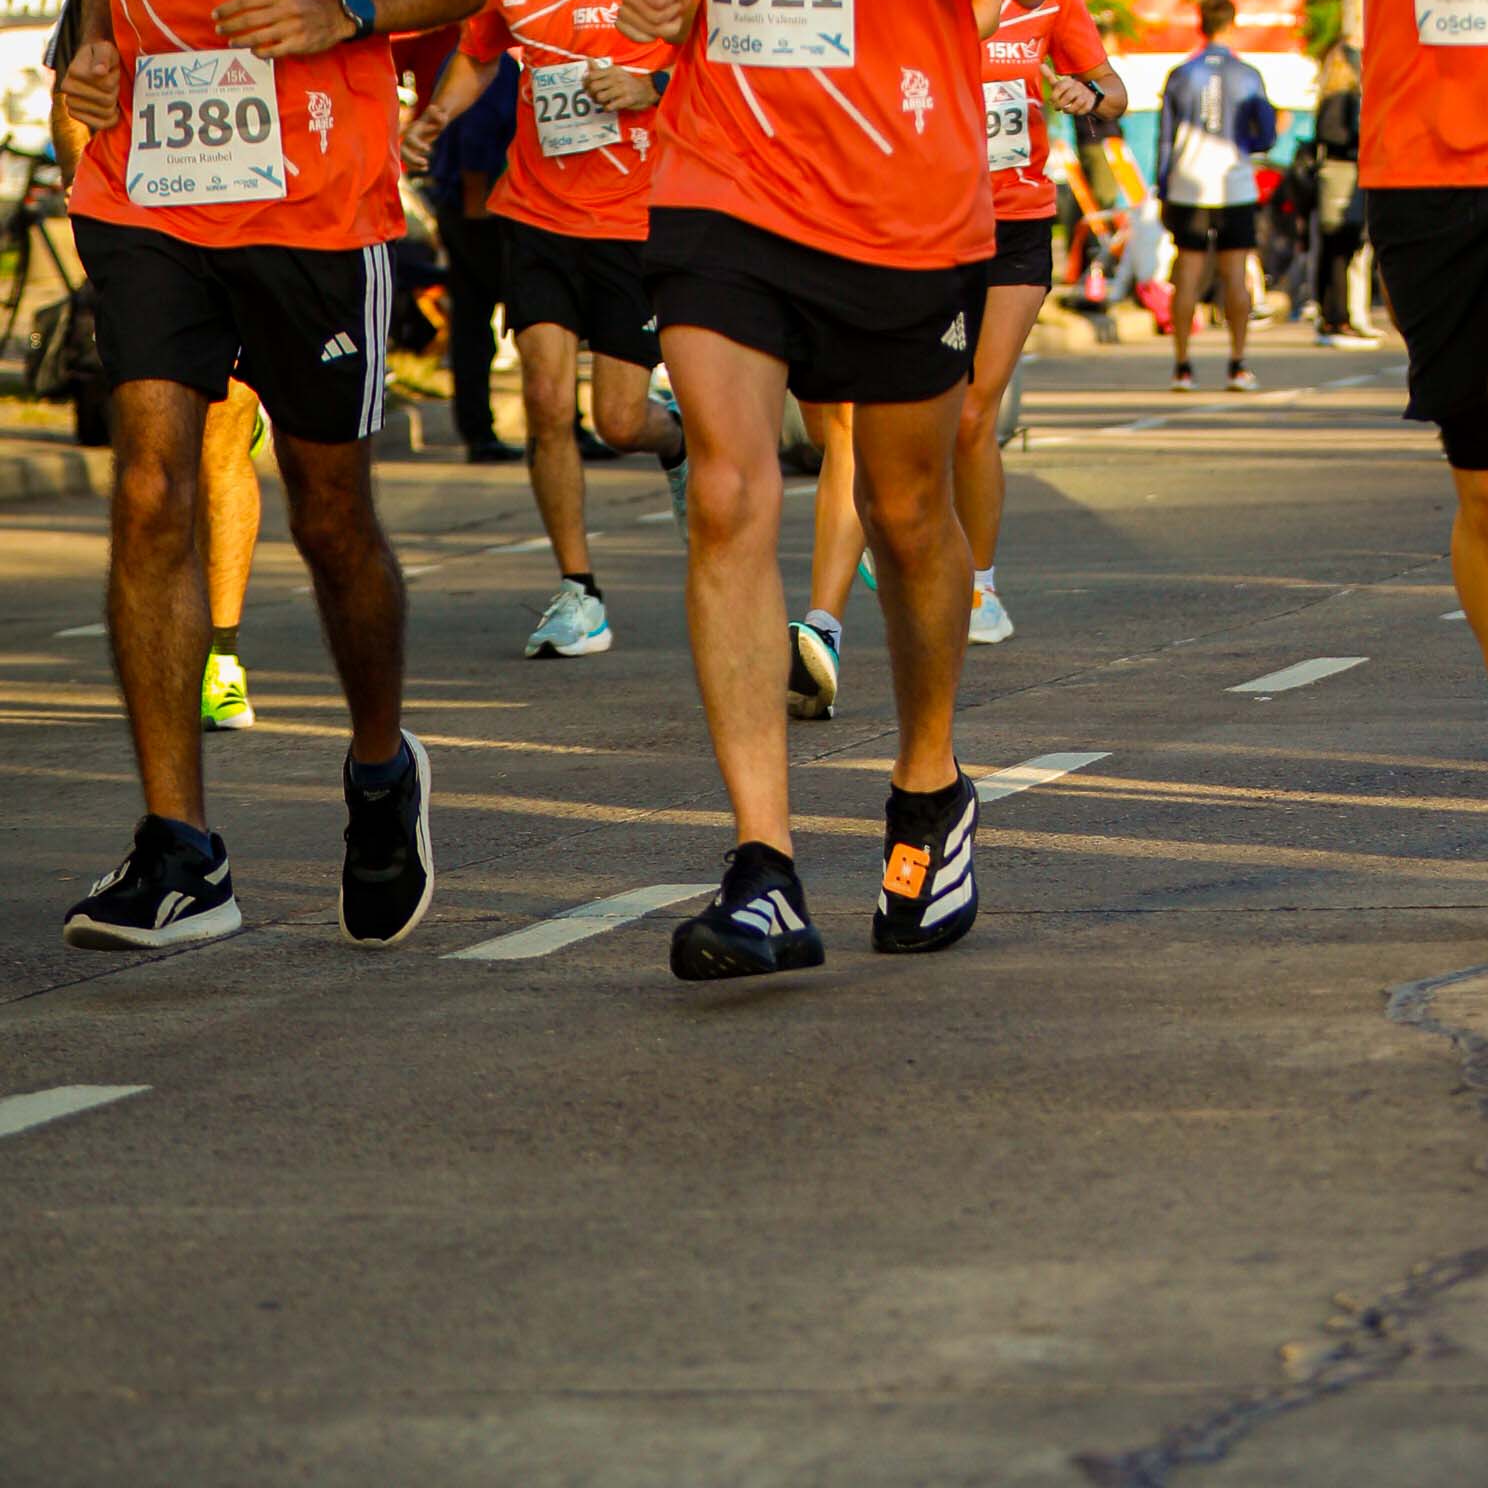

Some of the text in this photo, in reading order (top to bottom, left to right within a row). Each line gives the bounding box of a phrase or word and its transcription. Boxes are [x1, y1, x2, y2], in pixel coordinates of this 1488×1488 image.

[1436, 15, 1487, 33] osde
[722, 33, 762, 54] osde
[987, 42, 1020, 59] 15K
[145, 66, 178, 89] 15K
[227, 69, 249, 83] 15K
[535, 88, 606, 123] 226
[138, 96, 272, 151] 1380
[167, 152, 232, 164] Guerra Raubel
[147, 175, 196, 197] osde
